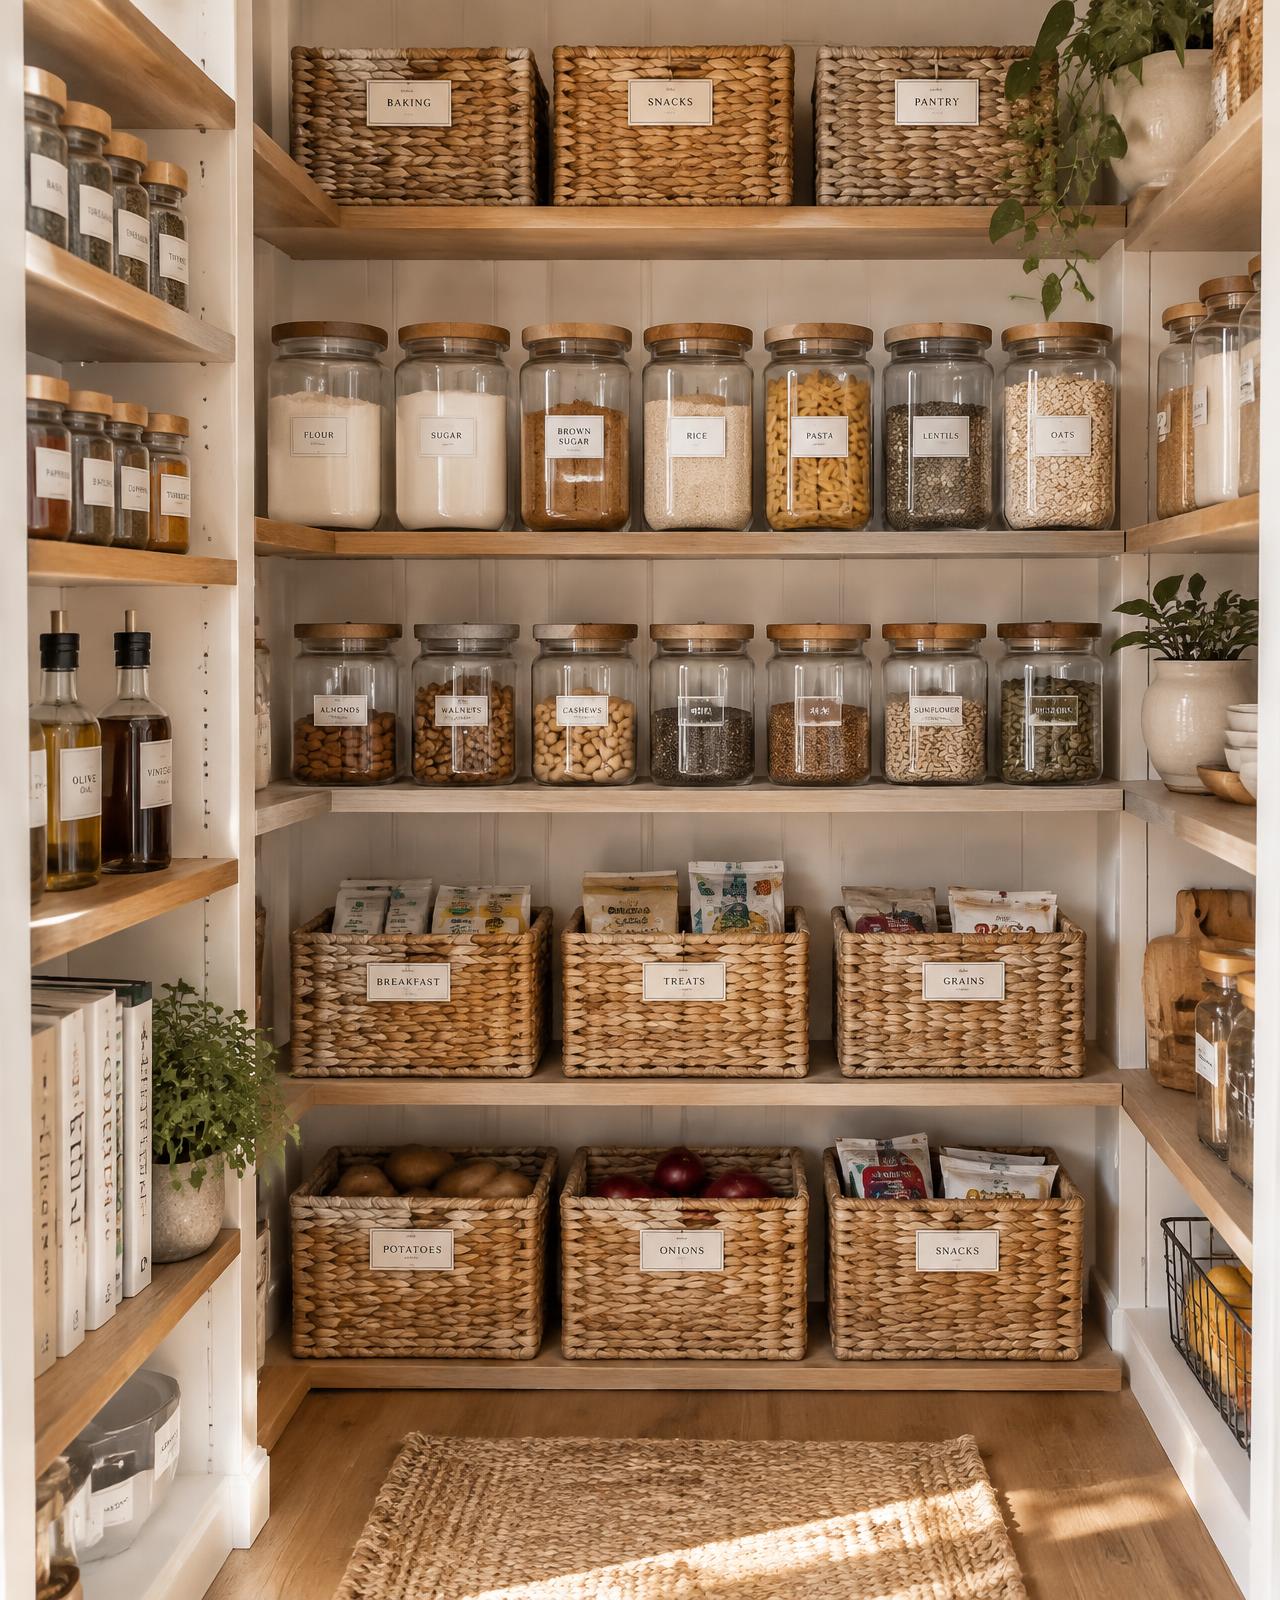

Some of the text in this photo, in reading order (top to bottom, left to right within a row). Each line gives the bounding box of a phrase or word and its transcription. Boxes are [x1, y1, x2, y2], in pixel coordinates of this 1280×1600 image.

[387, 98, 431, 107] BAKING
[648, 97, 693, 106] SNACKS
[915, 97, 959, 106] PANTRY
[303, 431, 334, 439] FLOUR
[430, 431, 462, 439] SUGAR
[557, 427, 591, 435] BROWN
[1050, 431, 1075, 439] OATS
[686, 432, 708, 440] RICE
[806, 432, 833, 440] PASTA
[923, 432, 959, 440] LENTILS
[320, 706, 360, 714] ALMONDS
[441, 706, 482, 714] WALNUTS
[562, 706, 602, 714] CASHEWS
[72, 773, 97, 785] OLIVE
[376, 977, 440, 986] BREAKFAST
[664, 977, 705, 986] TREATS
[943, 976, 985, 985] GRAINS
[383, 1245, 442, 1254] POTATOES
[659, 1246, 705, 1255] ONIONS
[935, 1246, 980, 1255] SNACKS
